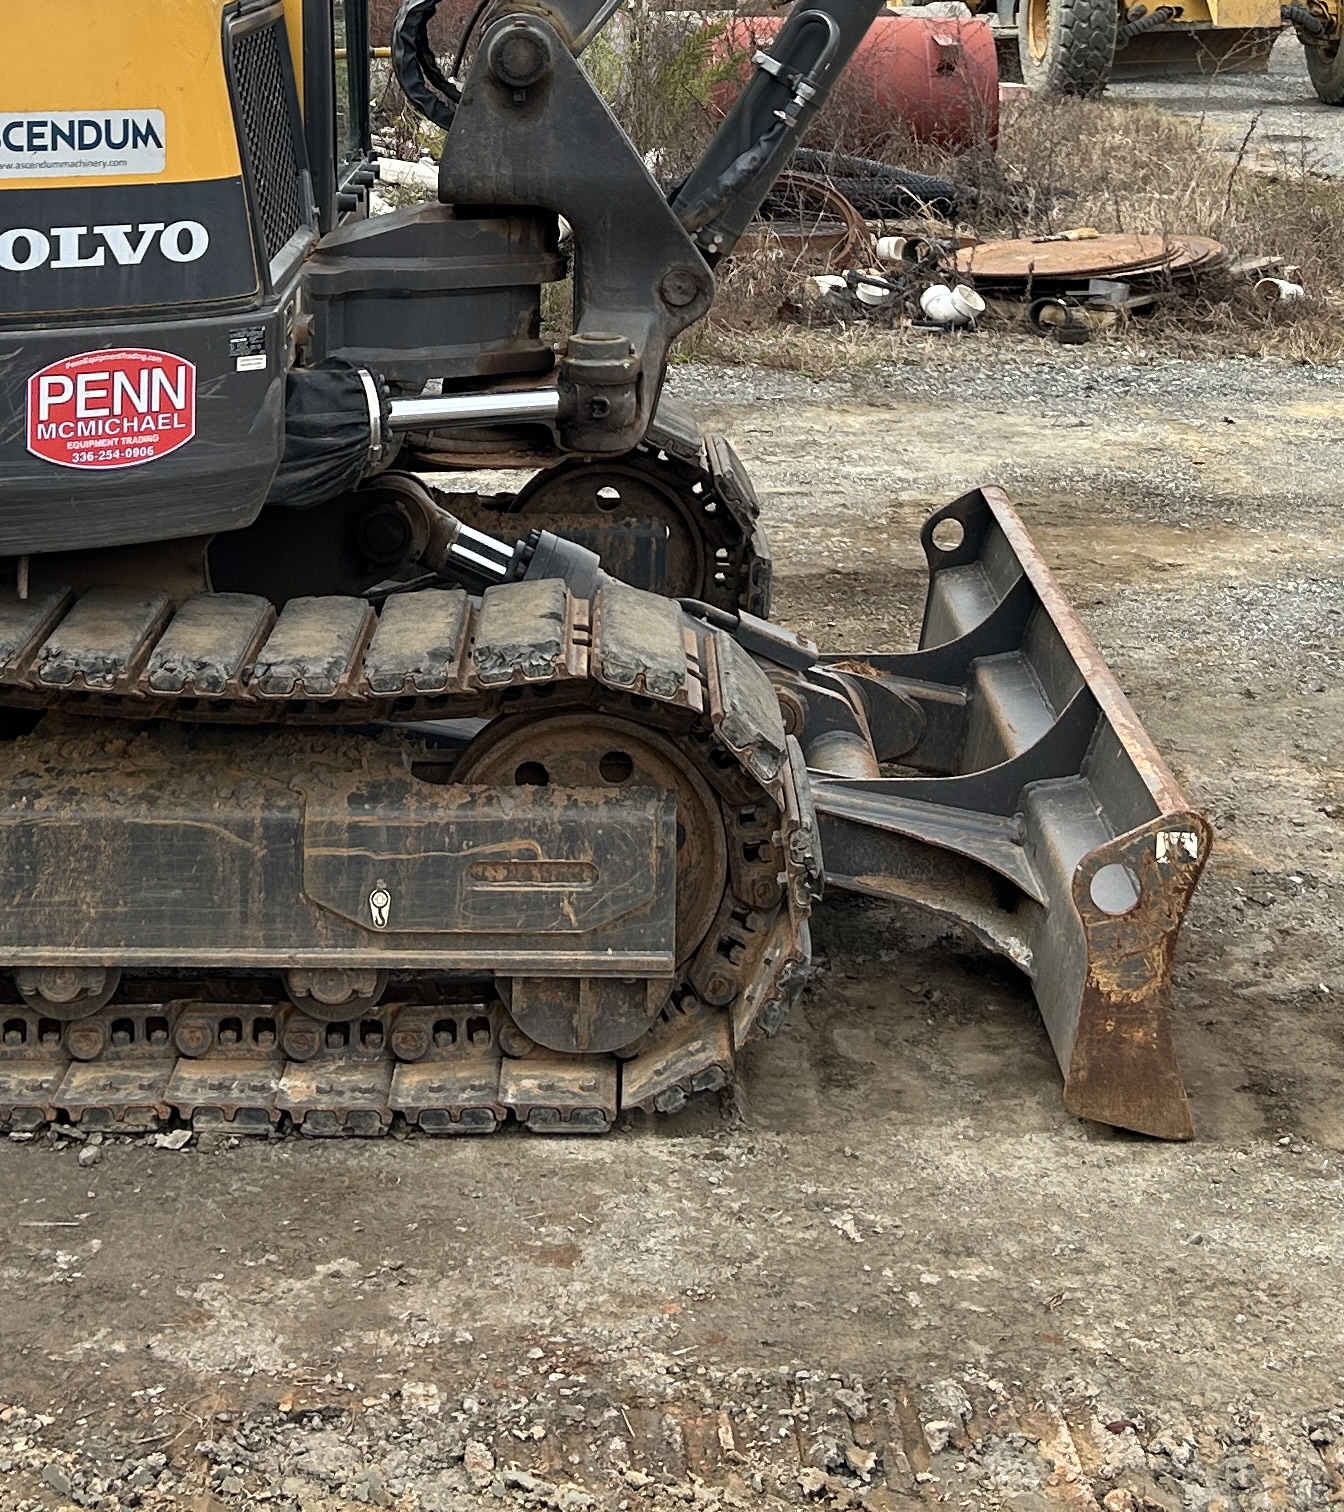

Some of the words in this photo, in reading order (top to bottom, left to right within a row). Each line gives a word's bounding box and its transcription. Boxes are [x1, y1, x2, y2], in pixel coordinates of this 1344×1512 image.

[39, 365, 186, 421] PENN
[37, 413, 186, 440] MCMICHAEL
[66, 438, 119, 450] EQUIPMENT
[121, 434, 159, 446] TRADING
[72, 446, 155, 463] 336-254-0906
